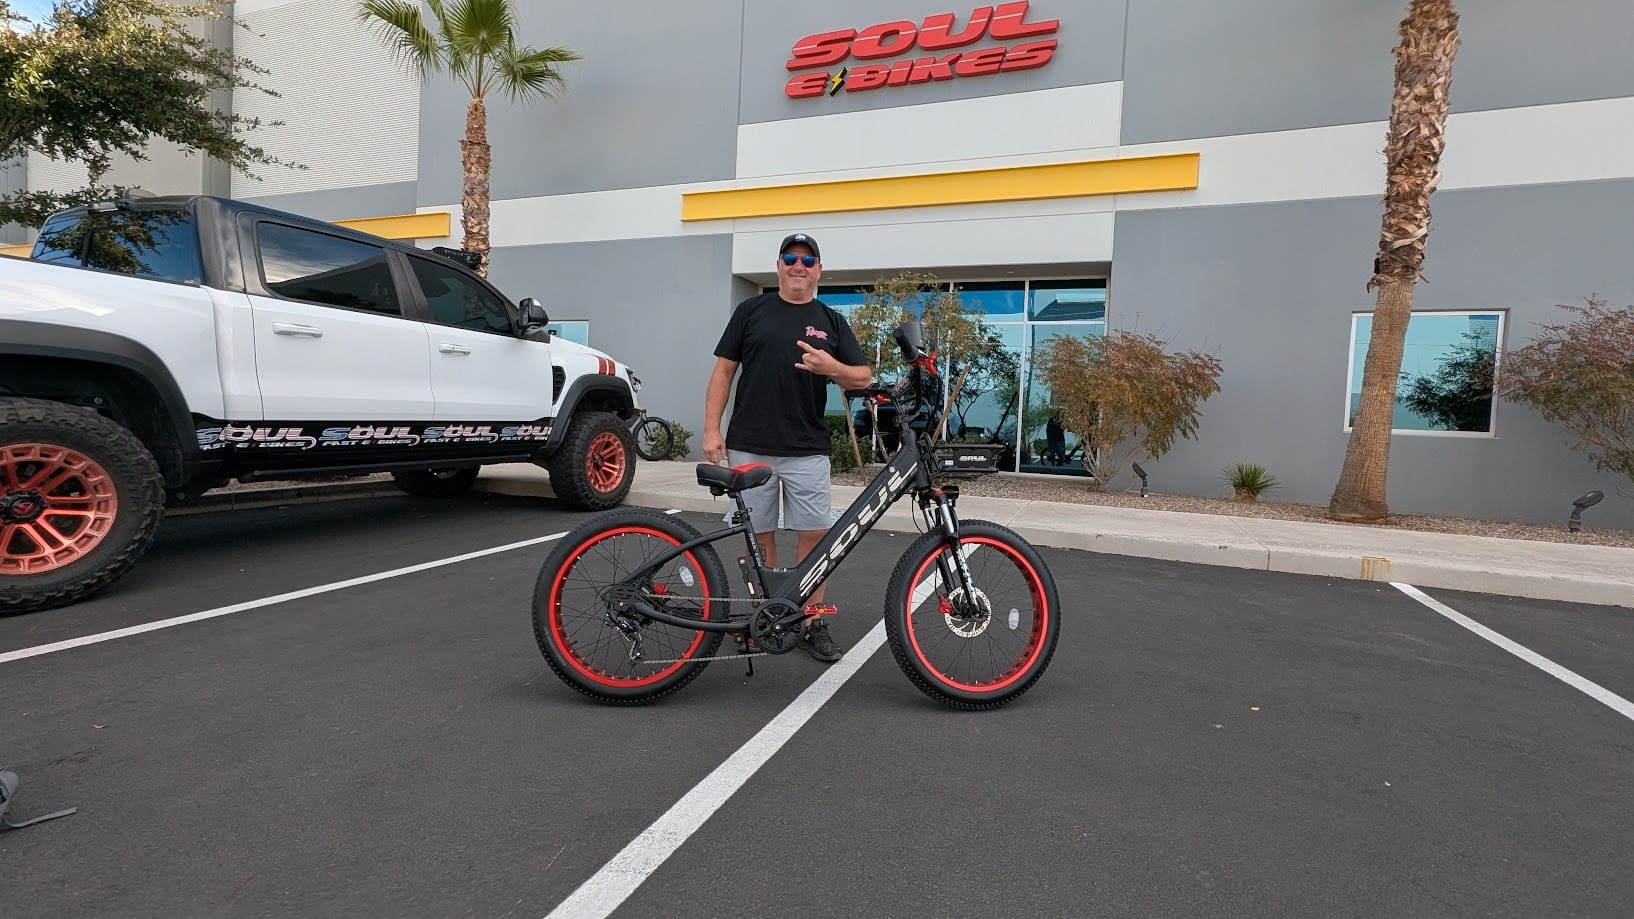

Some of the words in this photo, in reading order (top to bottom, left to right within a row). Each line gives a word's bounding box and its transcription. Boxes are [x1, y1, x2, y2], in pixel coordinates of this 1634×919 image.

[786, 0, 1059, 71] SOUL
[785, 72, 829, 99] E
[845, 39, 1058, 92] BIKES
[196, 424, 317, 450] SOUL
[319, 425, 420, 445] SOUL
[421, 424, 498, 443] SOUL
[799, 462, 918, 597] SOUL
